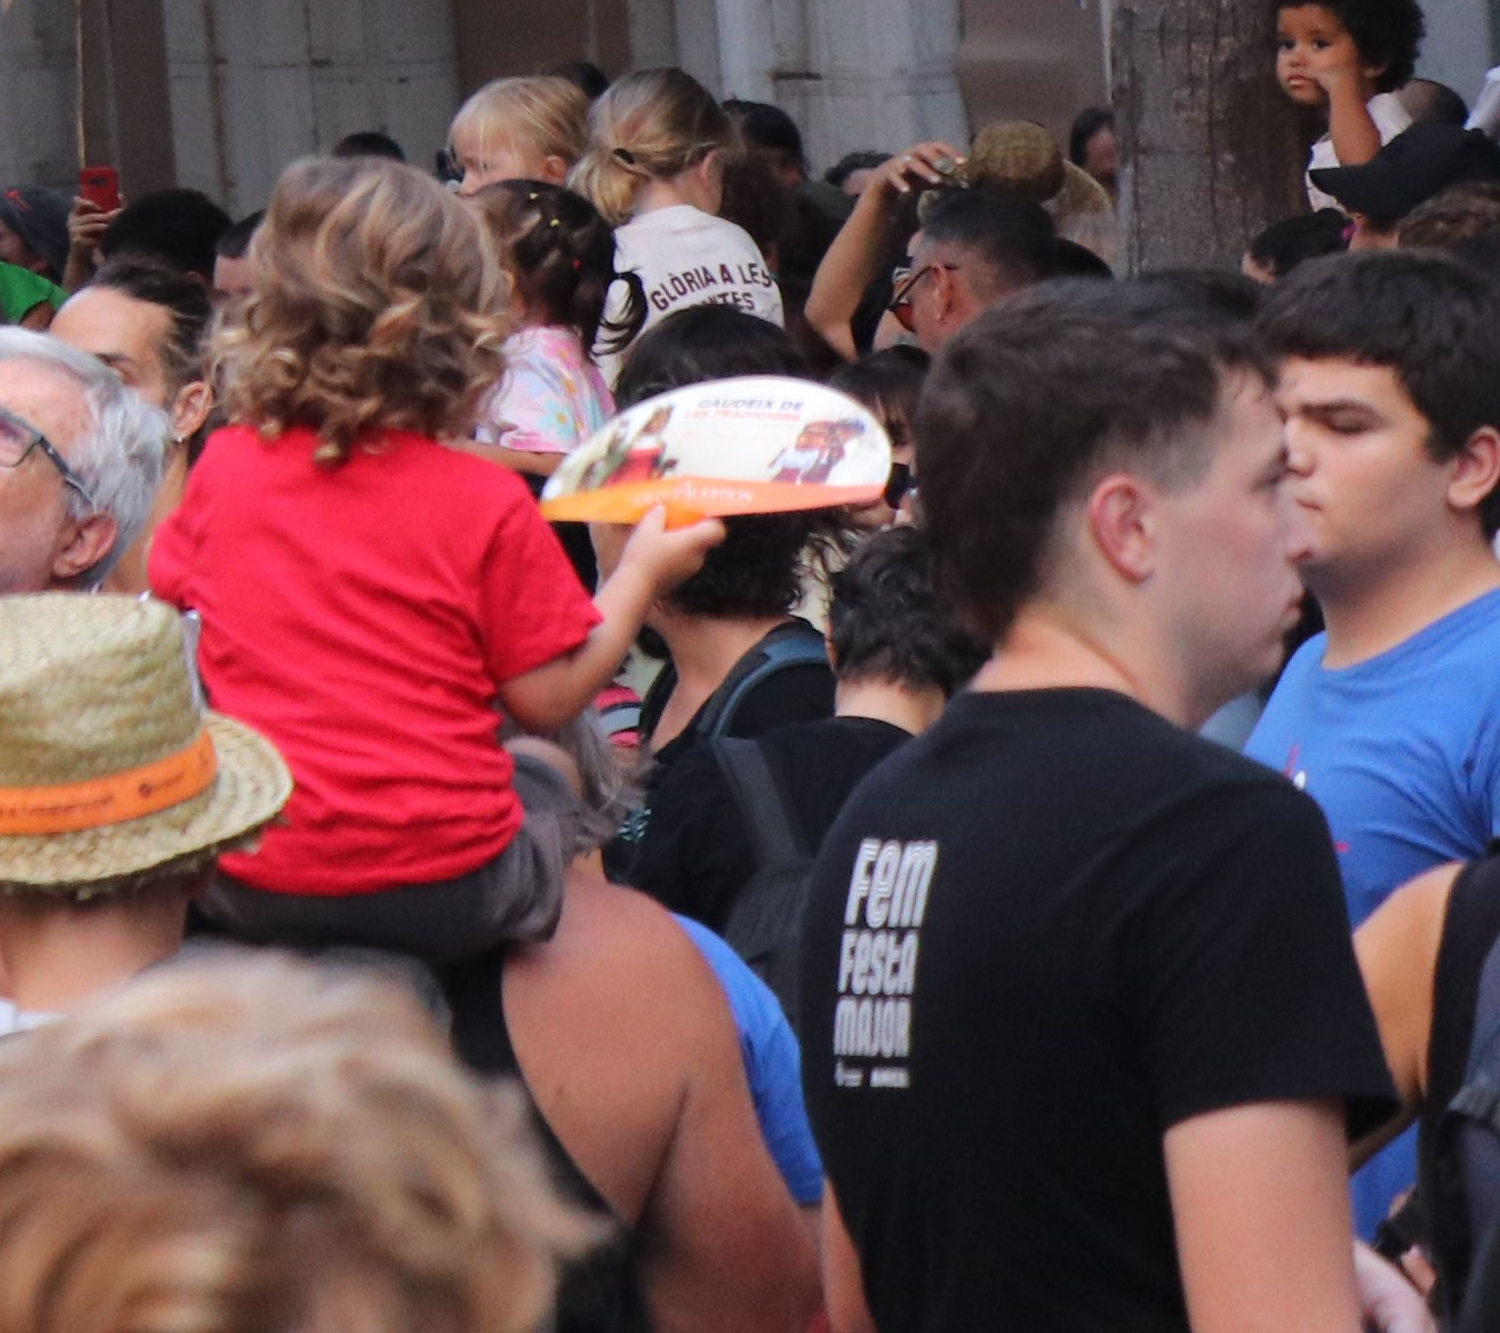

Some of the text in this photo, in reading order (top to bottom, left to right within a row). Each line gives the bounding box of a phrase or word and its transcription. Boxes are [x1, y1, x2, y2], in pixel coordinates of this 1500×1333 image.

[650, 262, 773, 311] GLÒRIA A LES
[779, 400, 804, 411] DE
